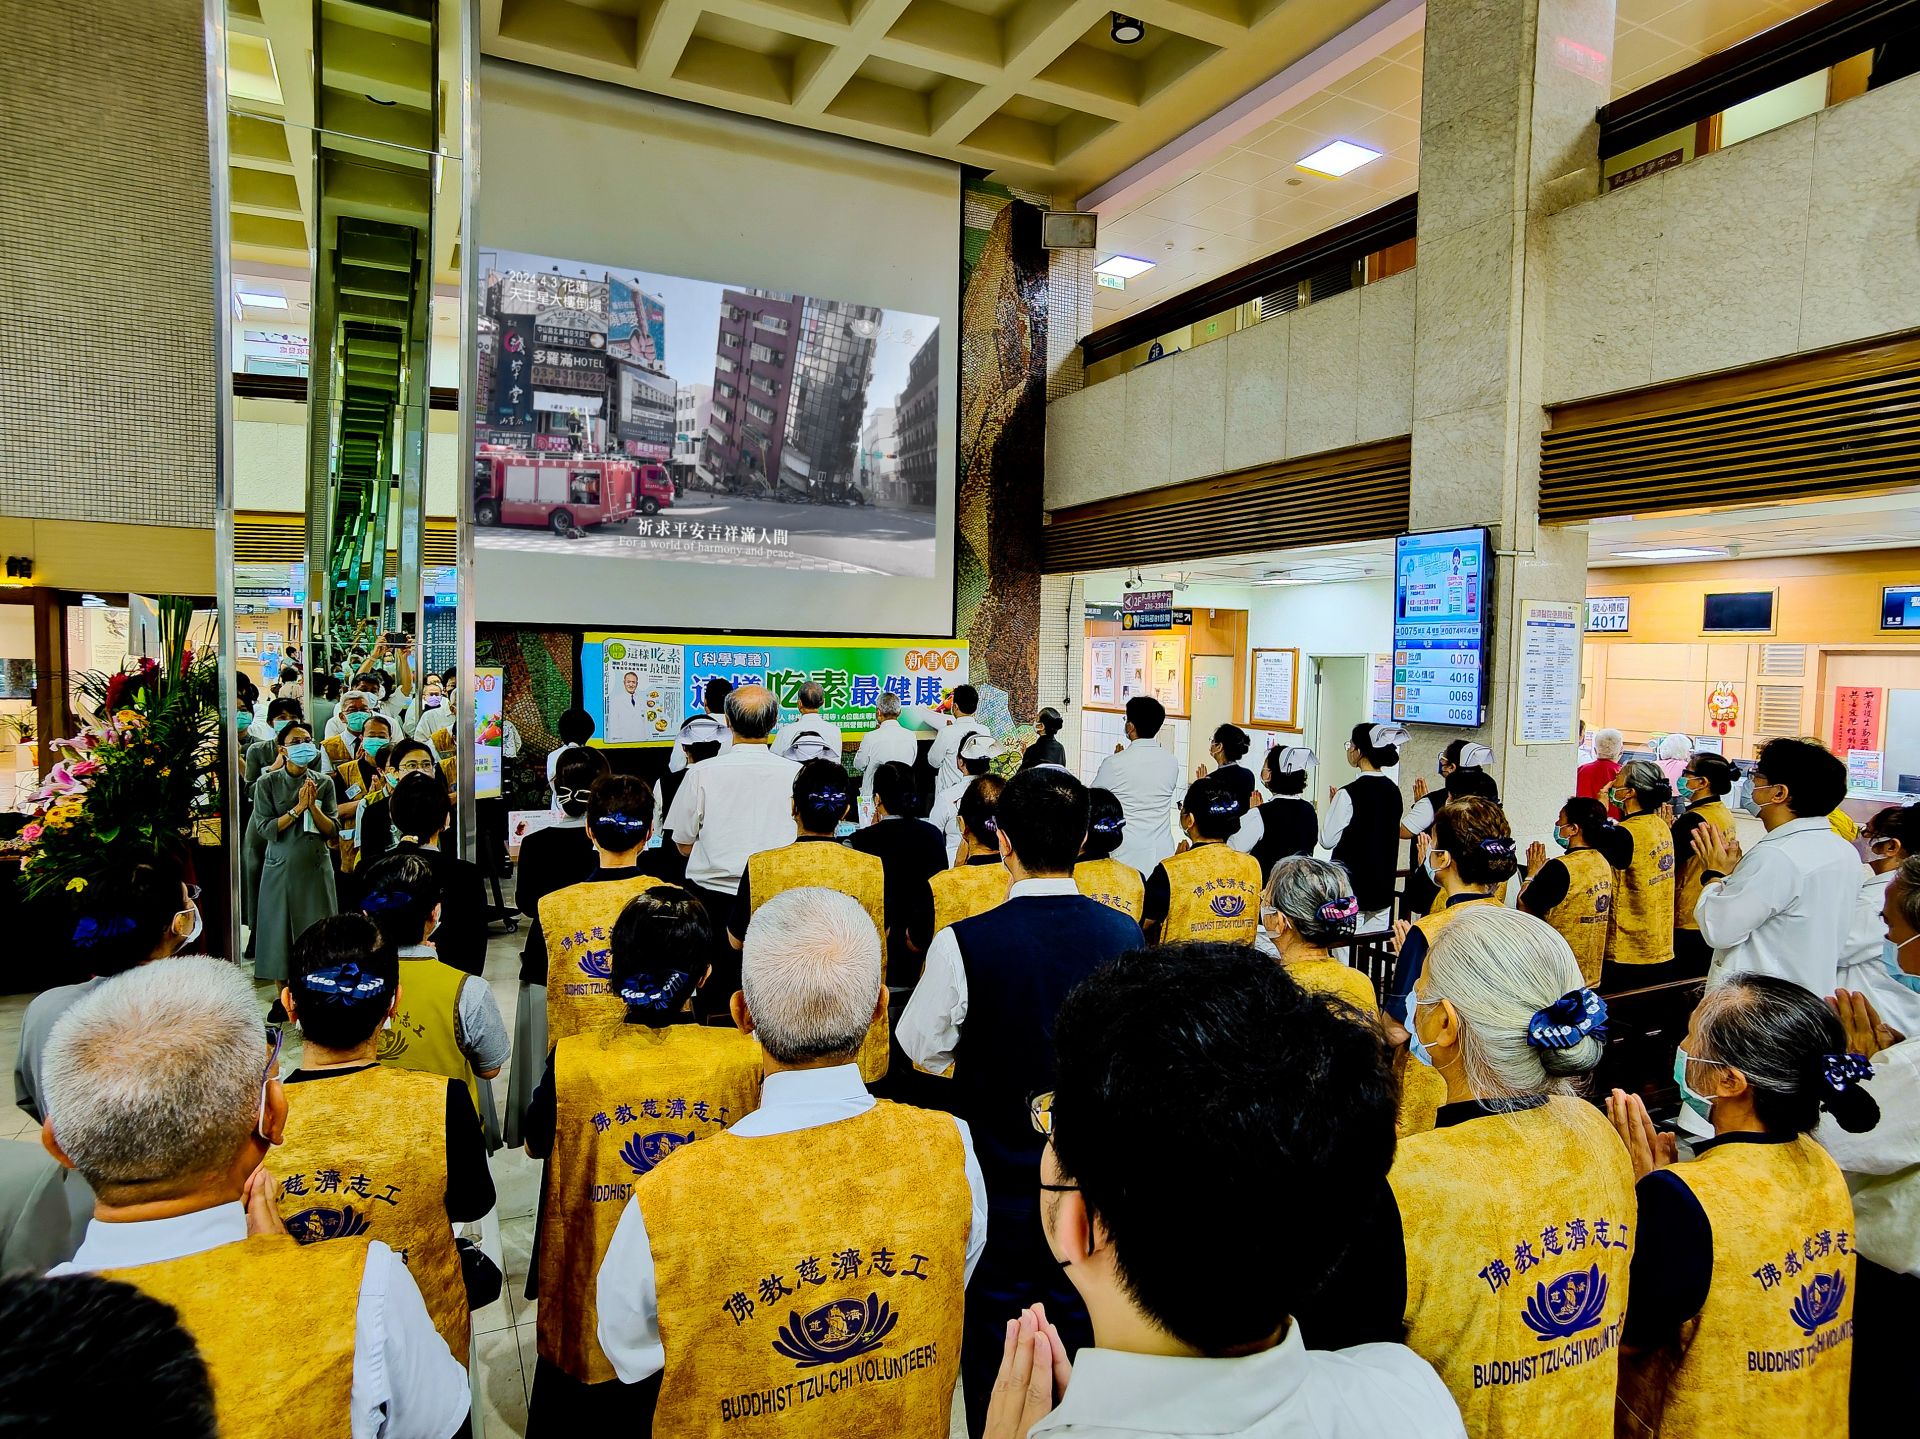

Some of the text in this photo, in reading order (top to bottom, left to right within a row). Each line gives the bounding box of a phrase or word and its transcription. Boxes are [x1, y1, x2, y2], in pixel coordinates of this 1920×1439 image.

[509, 270, 588, 294] 2024.4.3 花蓮
[637, 518, 789, 546] 祈求平安吉祥滿人間
[618, 535, 639, 548] For
[650, 539, 681, 551] world
[683, 540, 698, 551] of
[698, 540, 742, 557] harmony
[745, 545, 764, 557] and
[766, 549, 795, 559] peace
[1591, 615, 1626, 629] 4017
[907, 651, 960, 671] 新書會
[1450, 653, 1475, 665] 0070
[1449, 672, 1475, 684] 4016
[1449, 690, 1474, 702] 0069
[1448, 708, 1473, 721] 0068
[560, 926, 613, 952] 佛教慈
[589, 1097, 730, 1136] 佛教慈濟志工
[280, 1168, 402, 1207] 慈濟志工
[1477, 1217, 1629, 1295] 佛教慈濟志工
[721, 1246, 930, 1327] 佛教慈濟志工
[1473, 1355, 1539, 1390] BUDDHIST
[1540, 1339, 1583, 1377] TZU-CHI
[1747, 1347, 1806, 1373] BUDDHIST
[721, 1342, 938, 1423] BUDDHIST TZU-CHI VOLUNTEERS
